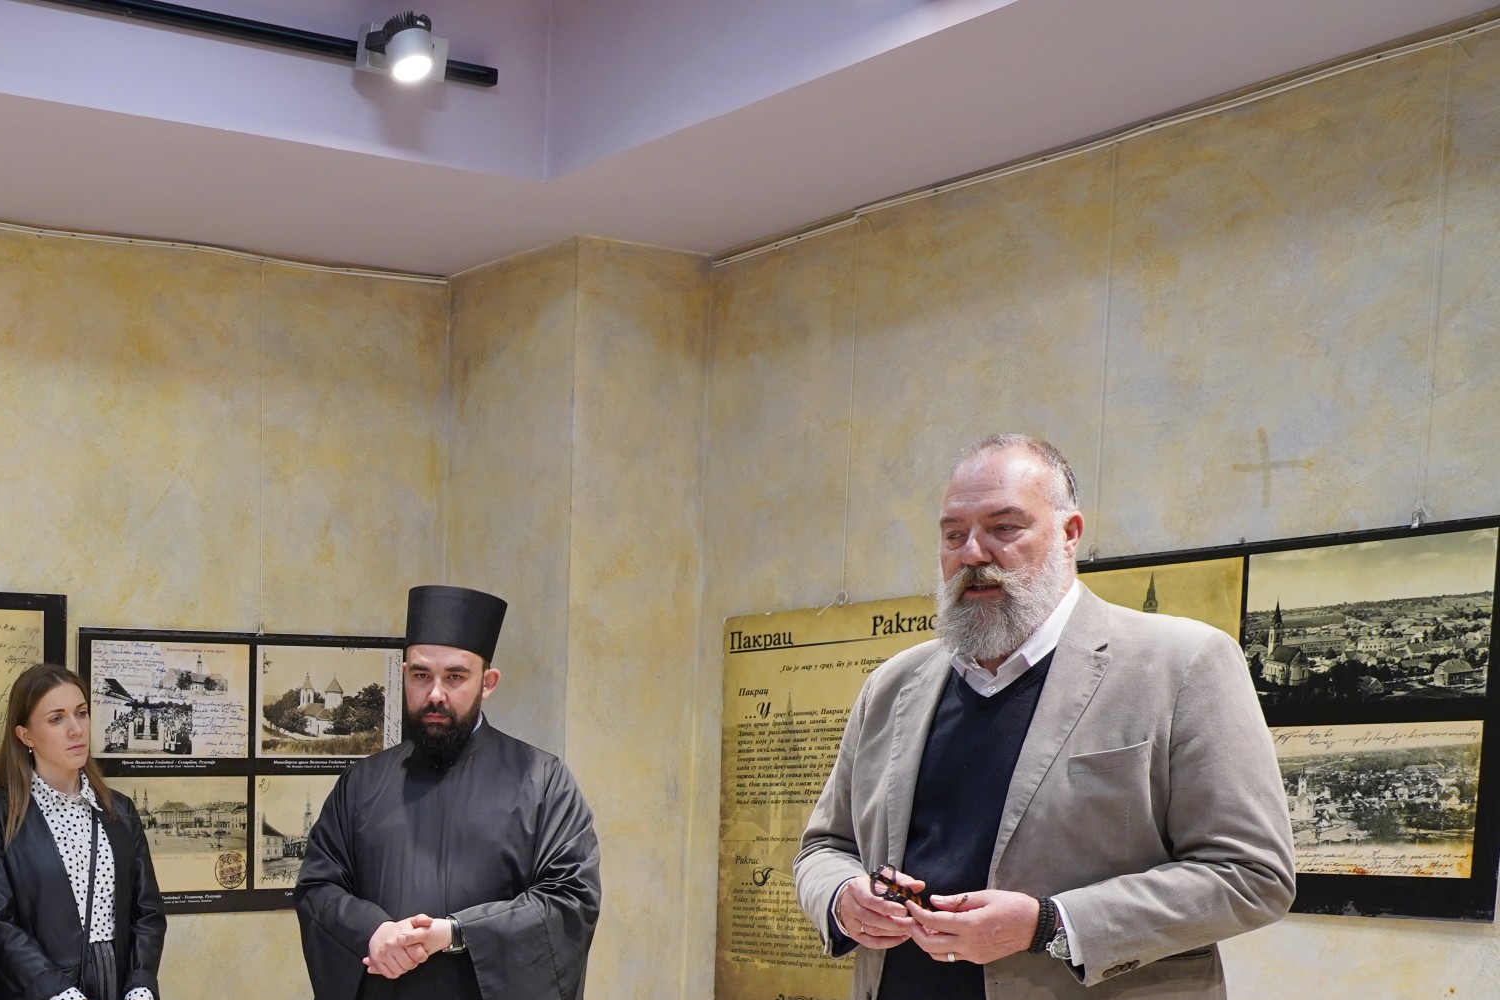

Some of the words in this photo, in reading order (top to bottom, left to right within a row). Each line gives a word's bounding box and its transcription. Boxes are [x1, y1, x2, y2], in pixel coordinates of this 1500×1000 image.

[872, 611, 938, 636] Pakrac
[729, 631, 793, 651] Пакрац
[738, 688, 769, 698] Пакрац
[821, 708, 843, 717] Пакрац
[735, 856, 760, 864] Pakrac
